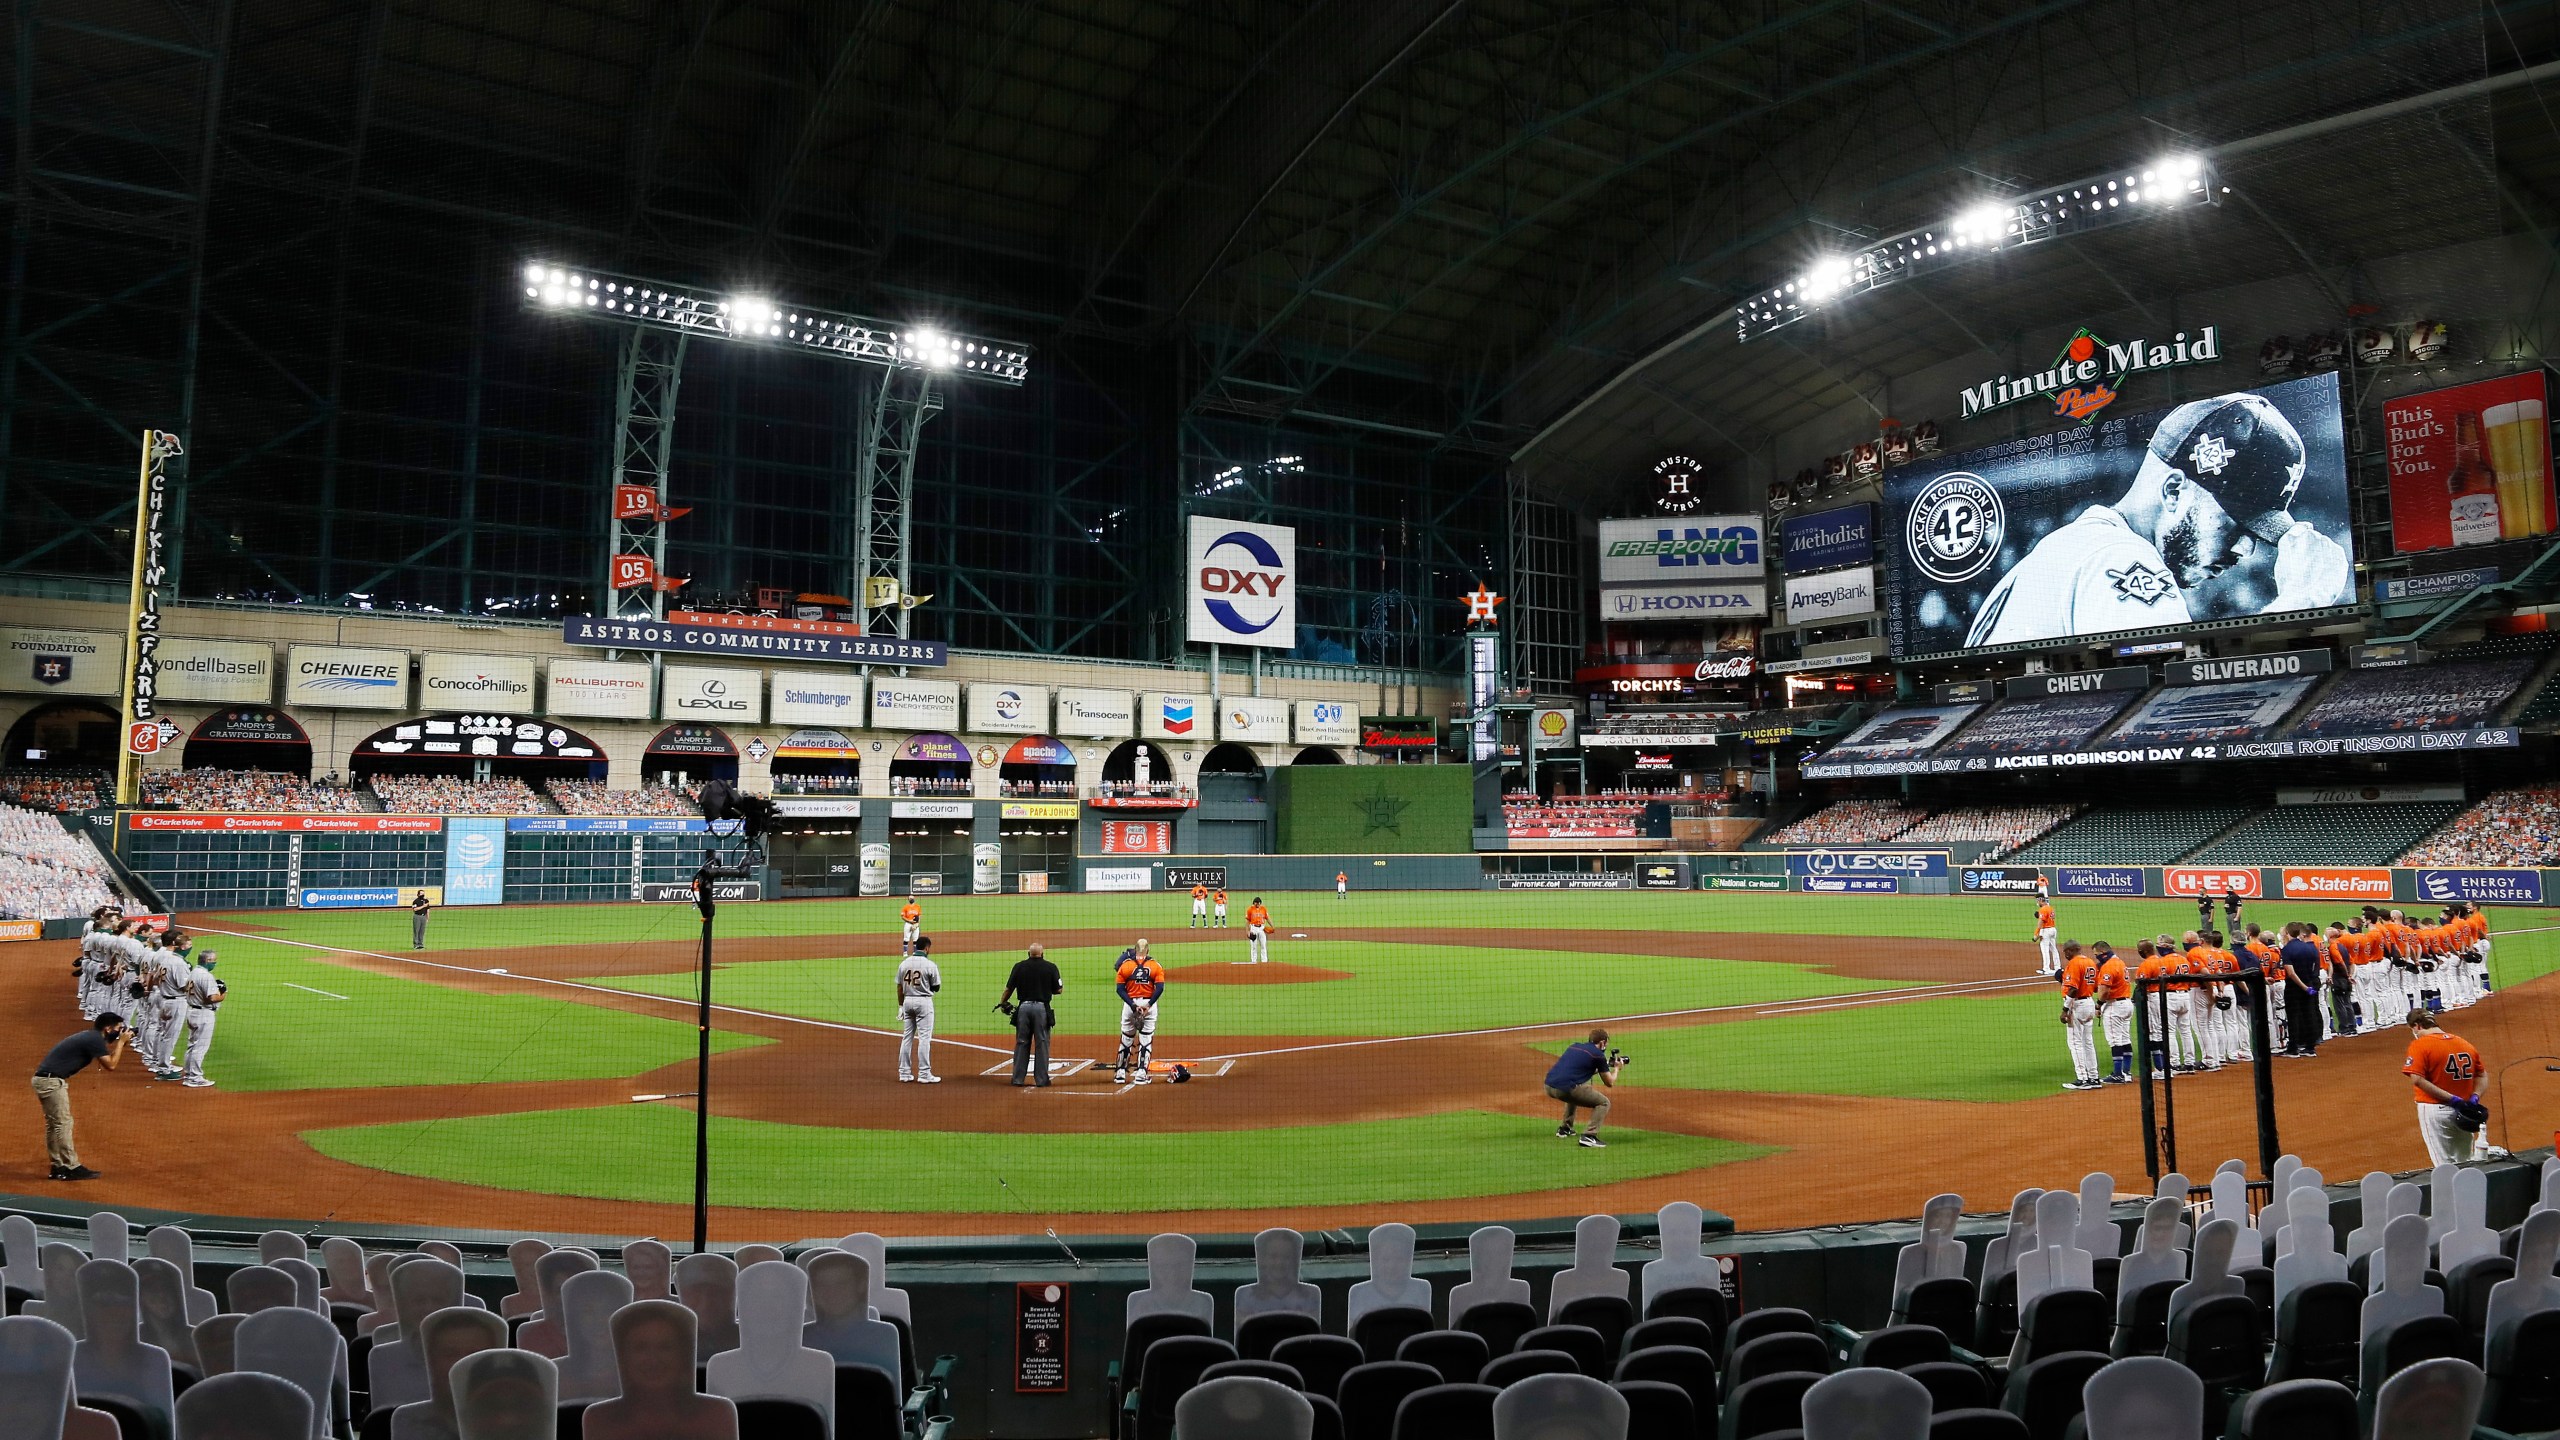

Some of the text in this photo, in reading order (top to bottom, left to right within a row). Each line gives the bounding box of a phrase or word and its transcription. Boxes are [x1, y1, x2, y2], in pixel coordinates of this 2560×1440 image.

[1960, 325, 2219, 418] Minute Maid
[2054, 383, 2118, 418] Park
[2388, 406, 2433, 426] This
[2058, 425, 2094, 442] DAY
[2101, 419, 2126, 434] 42
[2389, 420, 2444, 443] Bud's
[2058, 433, 2127, 456] DAY 42
[2391, 443, 2425, 460] For
[2203, 446, 2221, 463] 42
[1654, 455, 1703, 474] HOUSTON
[2392, 458, 2436, 476] You.
[1668, 474, 1690, 494] H
[626, 494, 647, 509] 19
[1657, 496, 1701, 512] ASTROS
[621, 508, 654, 517] CHAMPIONS
[1915, 482, 1995, 548] JACKIE ROBINSON DAY
[1933, 505, 1974, 542] 42
[2453, 520, 2497, 532] Budweiser
[1790, 524, 1865, 552] Methodist
[1611, 538, 1736, 556] FREEPORT
[1657, 525, 1758, 567] LNG
[621, 562, 645, 579] 05
[618, 577, 653, 588] CHAMPIONS
[1201, 567, 1285, 597] OXY
[2129, 574, 2156, 591] 42
[2407, 573, 2480, 588] CHAMPION
[873, 584, 891, 599] 17
[1791, 584, 1867, 609] AmegyBank
[2409, 586, 2440, 596] ENERGY
[1467, 592, 1497, 619] H
[1640, 594, 1752, 610] HONDA
[690, 615, 843, 632] MINUTE MAID
[21, 633, 89, 645] THE ASTROS
[580, 624, 935, 659] ASTROS COMMUNITY LEADERS
[11, 641, 96, 654] FOUNDATION
[44, 662, 61, 677] H
[300, 662, 399, 678] CHENIERE
[1695, 656, 1755, 680] Coca-Cola
[2191, 656, 2300, 681] SILVERADO
[2360, 660, 2409, 668] CHEVROLET
[135, 637, 157, 718] FARE
[555, 677, 644, 688] HALLIBURTON
[2046, 674, 2104, 694] CHEVY
[428, 676, 528, 695] ConocoPhillips
[593, 691, 627, 699] YEARS
[785, 689, 851, 707] Schlumberger
[893, 692, 954, 704] CHAMPION
[1163, 696, 1193, 704] Chevron
[1948, 695, 1980, 703] CHEVROLET
[678, 698, 748, 710] LEXUS
[893, 702, 921, 710] ENERGY
[996, 701, 1022, 709] OXY
[1076, 708, 1129, 719] Transocean
[1256, 715, 1284, 723] QUANTA
[209, 731, 292, 740] CRAWFORD BOXES
[459, 726, 513, 736] LANDRY'S
[1742, 727, 1792, 739] PLUCKERS
[786, 738, 849, 749] Crawford Bock
[923, 742, 952, 751] planet
[1363, 731, 1436, 747] Budweiser
[1659, 736, 1692, 744] TACOS
[661, 744, 725, 753] CRAWFORD BOXES
[925, 749, 957, 759] fitness
[1023, 746, 1057, 757] apache
[1807, 731, 2509, 777] JACKIE ROBINSON DAY 42 JACKIE ROBINSON DAY 42 JACKIE ROBINSON DAY 42
[919, 805, 959, 814] securian
[1029, 808, 1076, 817] PAPA JOHN'S
[89, 815, 113, 826] 315
[1128, 834, 1143, 845] 66
[1548, 827, 1597, 837] Budweiser
[633, 838, 641, 897] AMERICAN
[1884, 856, 1902, 864] 373
[289, 837, 300, 903] NATIONAL
[831, 865, 849, 873] 362
[1101, 871, 1142, 882] Insperity
[1179, 872, 1222, 881] VERITEX
[1980, 871, 2004, 880] AT&T
[452, 874, 496, 889] AT&T
[1719, 878, 1746, 887] National
[1759, 880, 1779, 888] Rental
[1980, 879, 2036, 890] SPORTSNET
[2066, 872, 2133, 887] Methodist
[2177, 874, 2247, 890] H-E-B
[2461, 877, 2516, 888] ENERGY
[319, 893, 392, 901] HIGGINBOTHAM
[2462, 887, 2533, 899] TRANSFER
[903, 969, 921, 987] 42
[2445, 1052, 2473, 1081] 42
